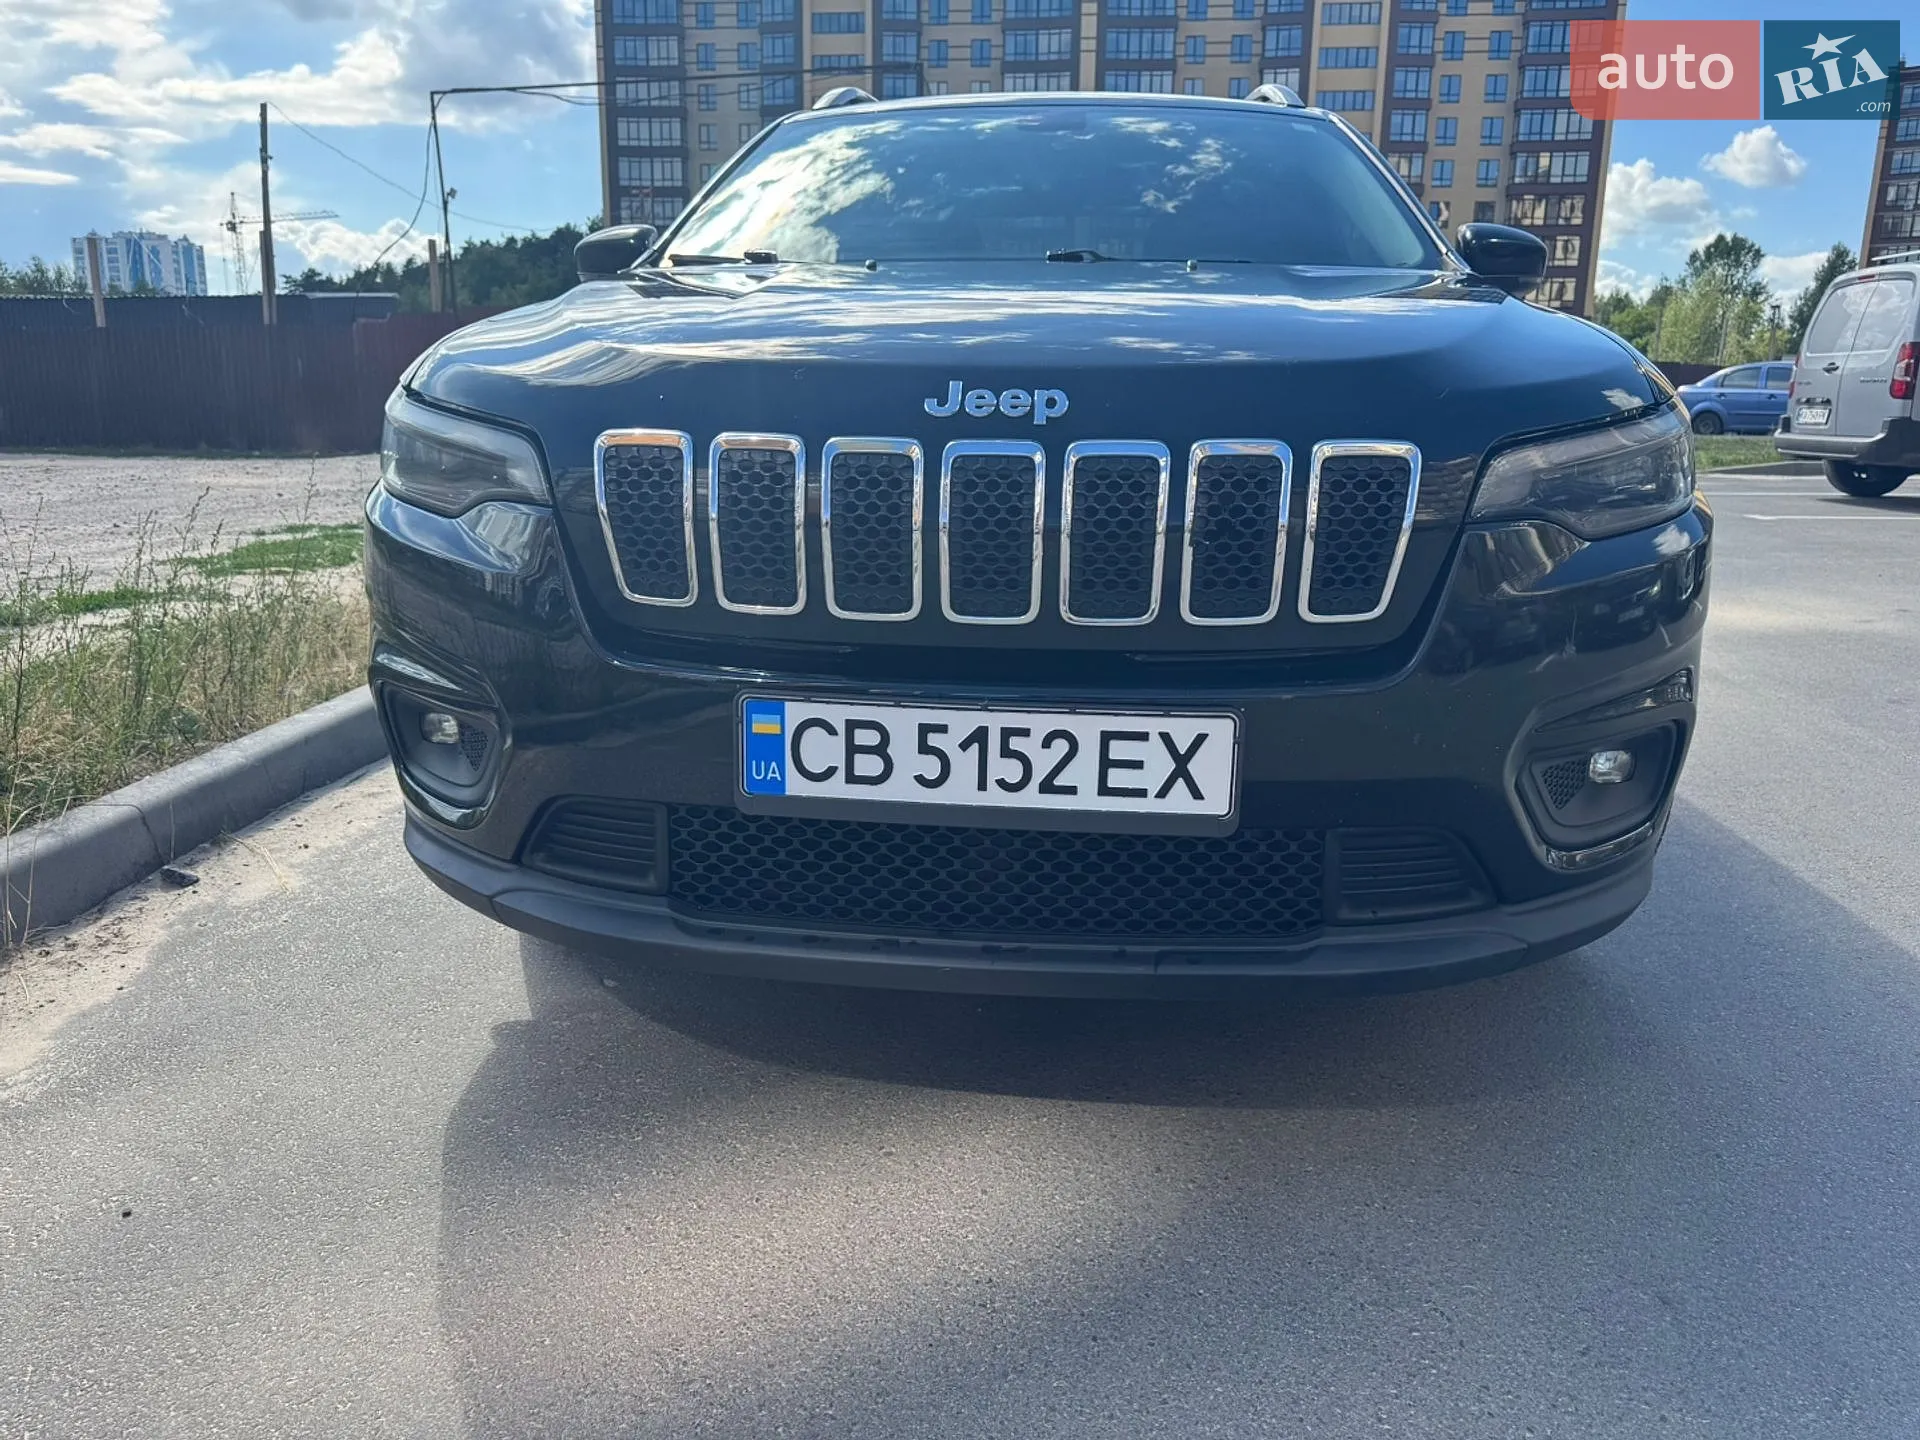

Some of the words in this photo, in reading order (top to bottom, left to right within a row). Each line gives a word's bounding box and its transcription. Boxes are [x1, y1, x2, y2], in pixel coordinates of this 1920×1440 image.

[924, 380, 1069, 425] Jeep
[752, 760, 782, 781] UA
[790, 717, 894, 786] CB
[913, 722, 1080, 795] 5152
[1097, 730, 1210, 800] EX
